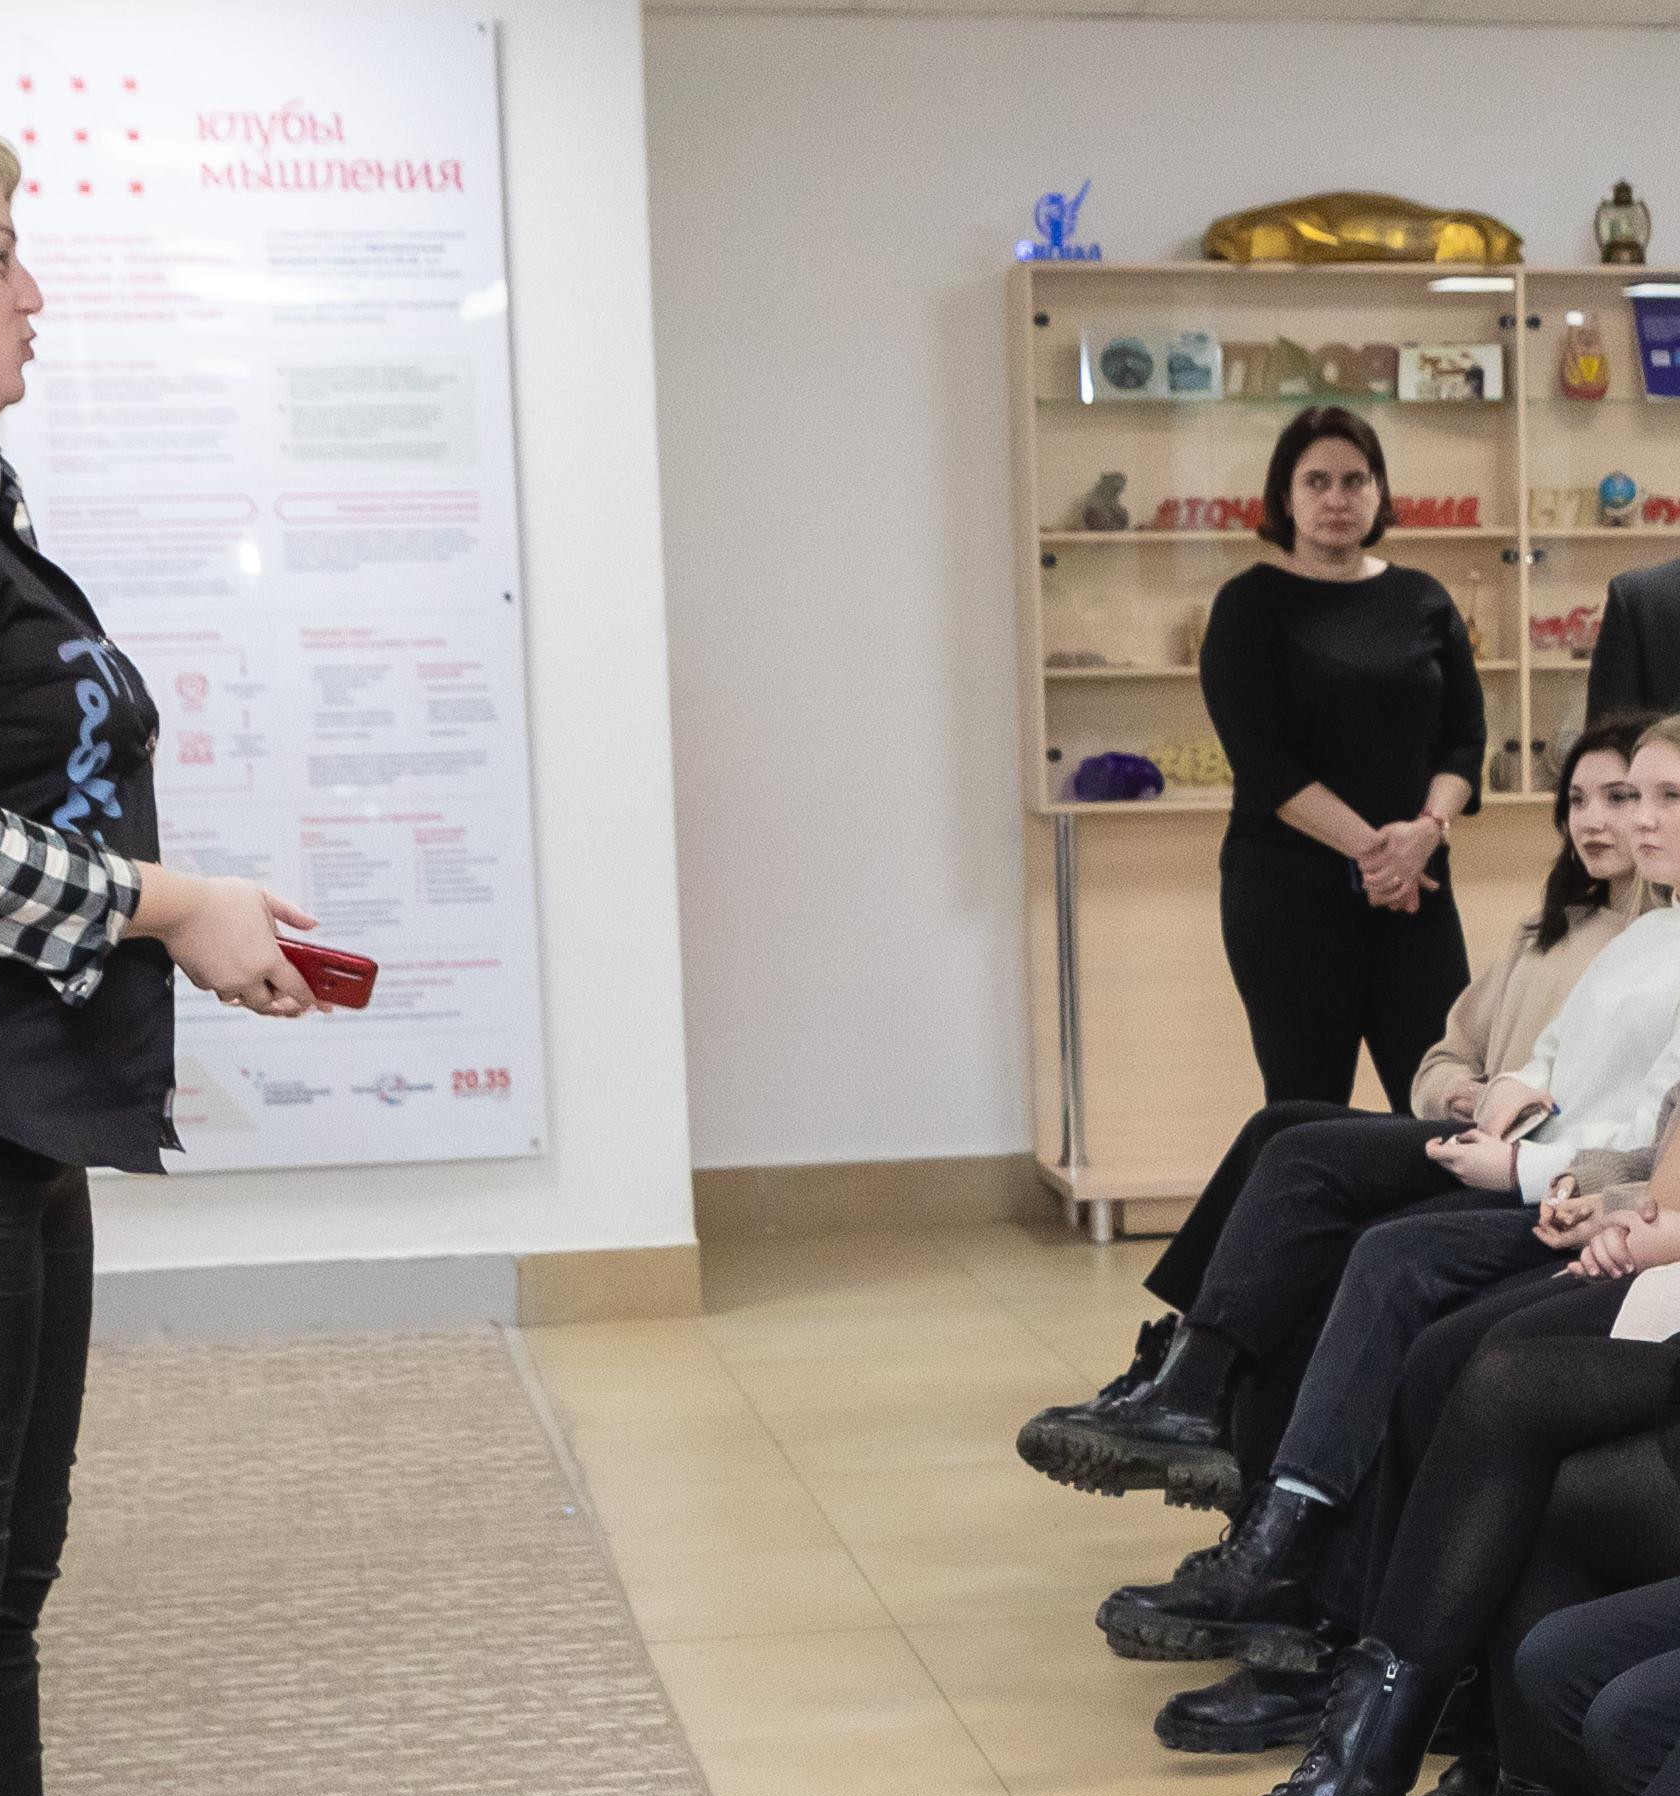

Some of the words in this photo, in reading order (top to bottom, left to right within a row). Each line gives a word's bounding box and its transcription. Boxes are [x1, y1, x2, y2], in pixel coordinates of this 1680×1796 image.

[195, 97, 345, 155] клубы
[199, 158, 465, 193] мышления
[452, 1066, 512, 1090] 20.35
